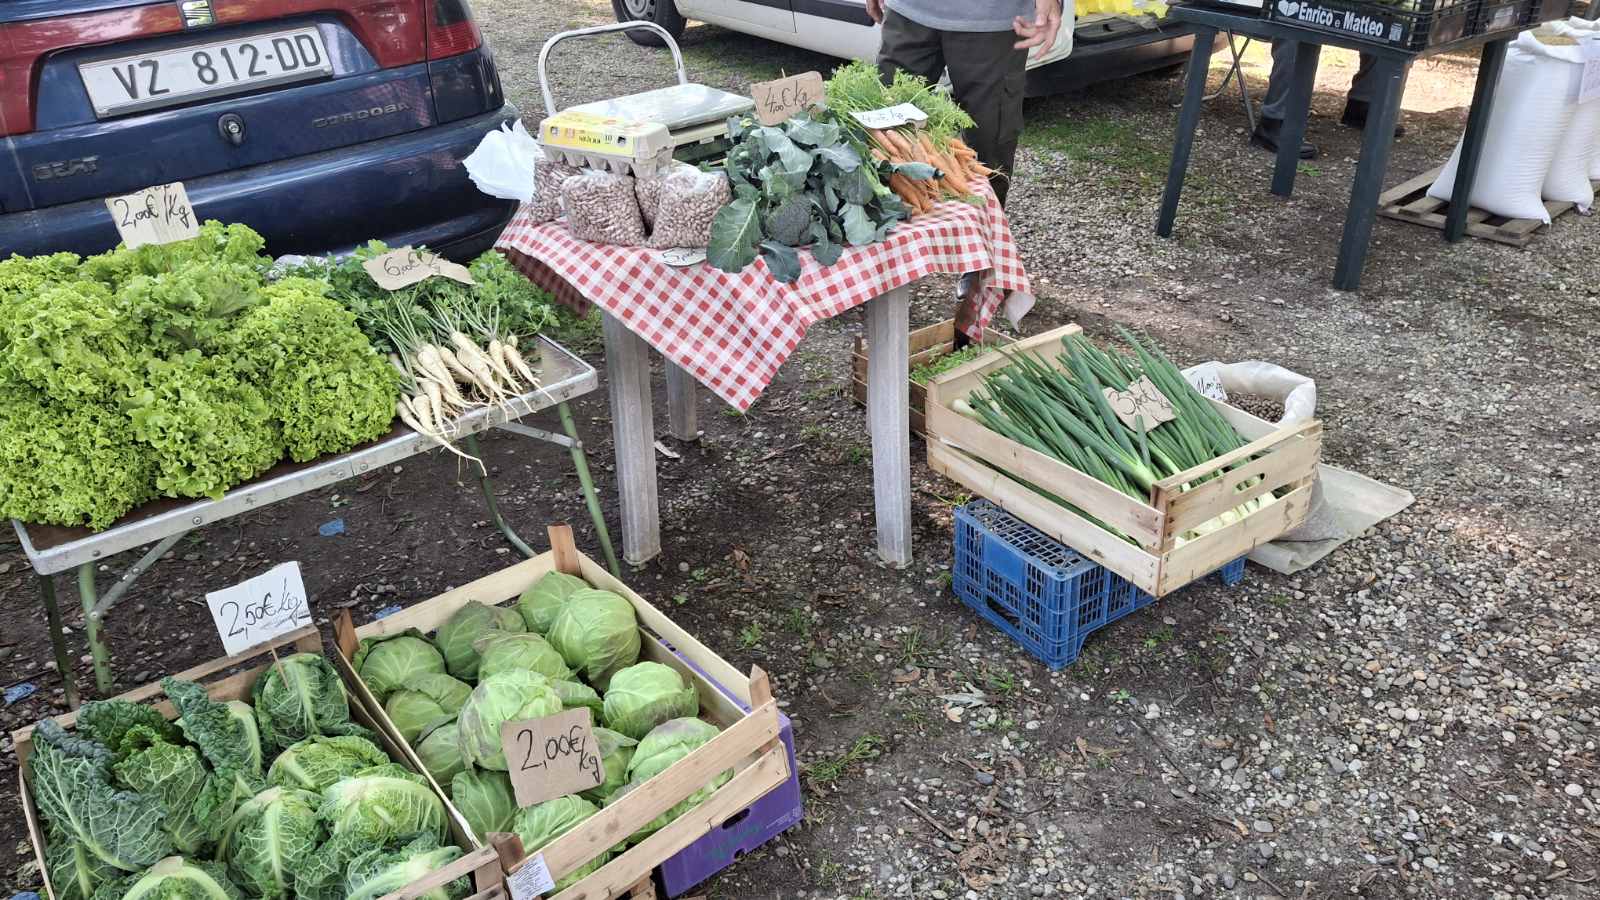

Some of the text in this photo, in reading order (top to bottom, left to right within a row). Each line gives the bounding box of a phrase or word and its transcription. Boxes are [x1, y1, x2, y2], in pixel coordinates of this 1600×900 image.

[1298, 2, 1334, 26] Enrico
[1334, 19, 1341, 28] e
[1342, 11, 1384, 37] Matteo
[112, 33, 321, 100] VZ 812-DD
[220, 592, 276, 640] 2,50€
[517, 725, 583, 772] 2,00€
